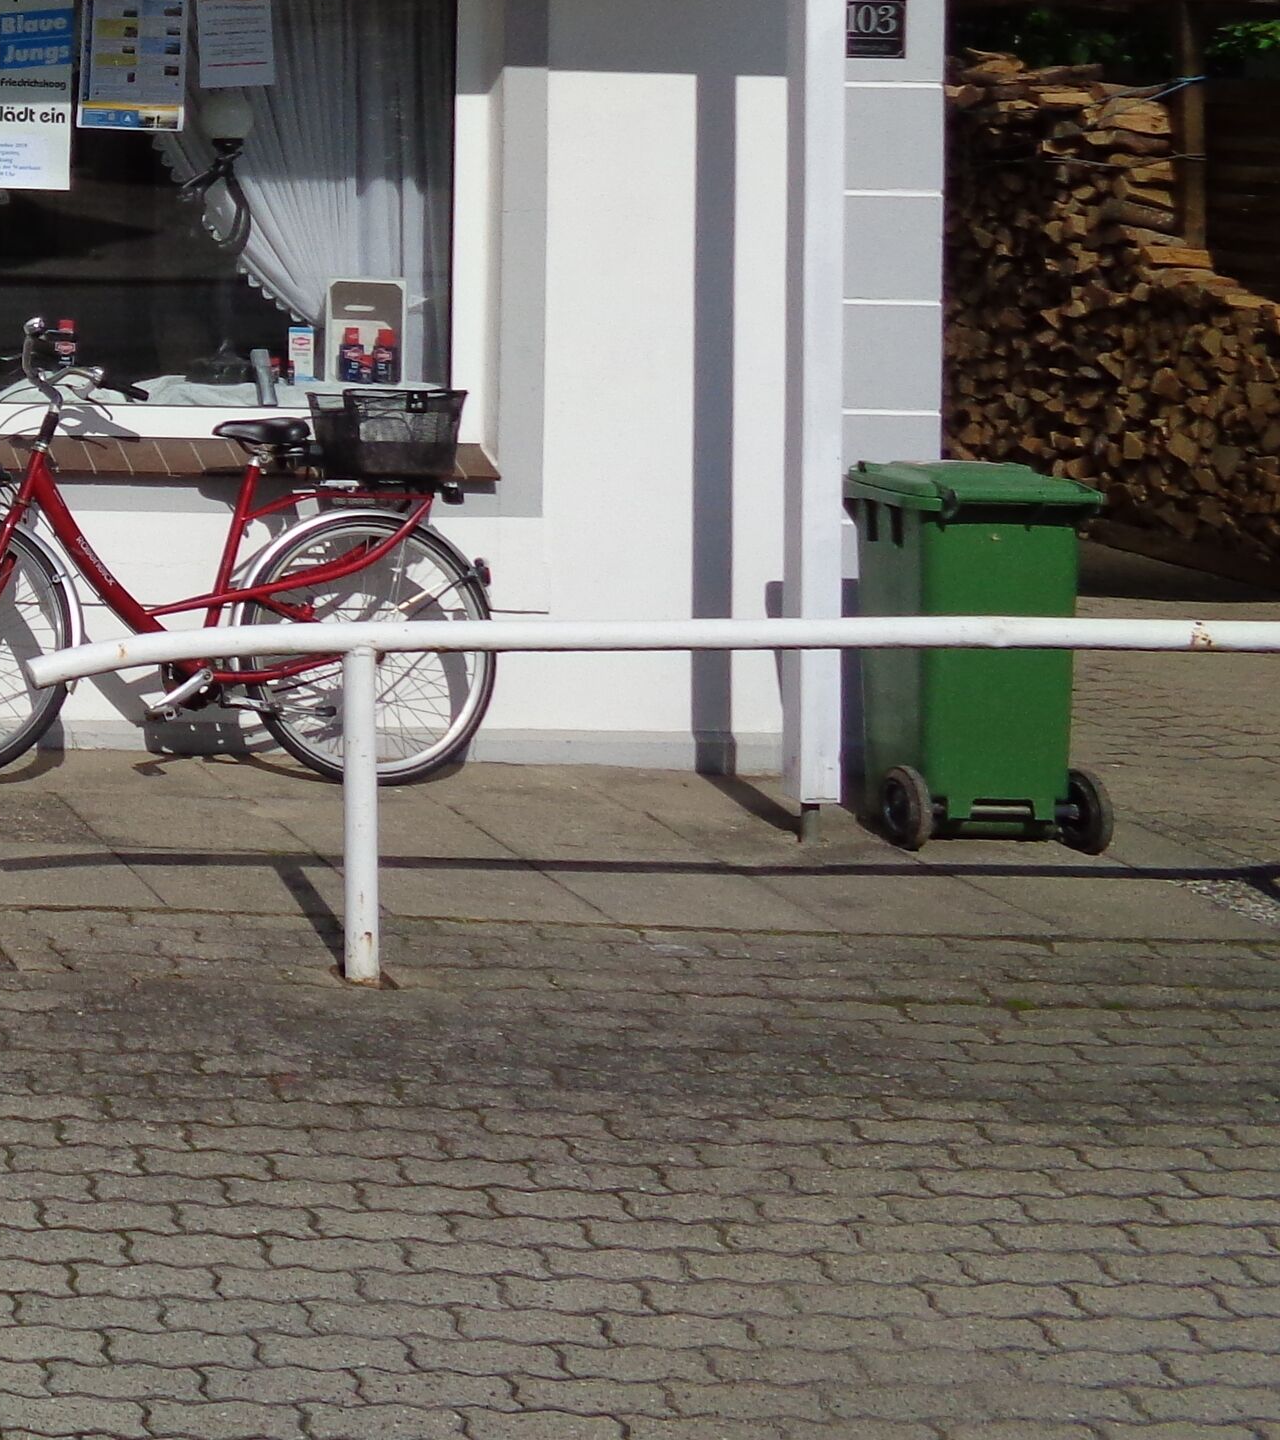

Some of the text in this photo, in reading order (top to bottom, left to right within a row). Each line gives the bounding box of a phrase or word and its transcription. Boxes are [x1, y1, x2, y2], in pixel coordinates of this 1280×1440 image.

[1, 13, 67, 34] Blaue
[847, 4, 897, 34] 103
[3, 44, 70, 65] Jungs
[0, 105, 35, 124] lädt
[39, 107, 66, 124] ein
